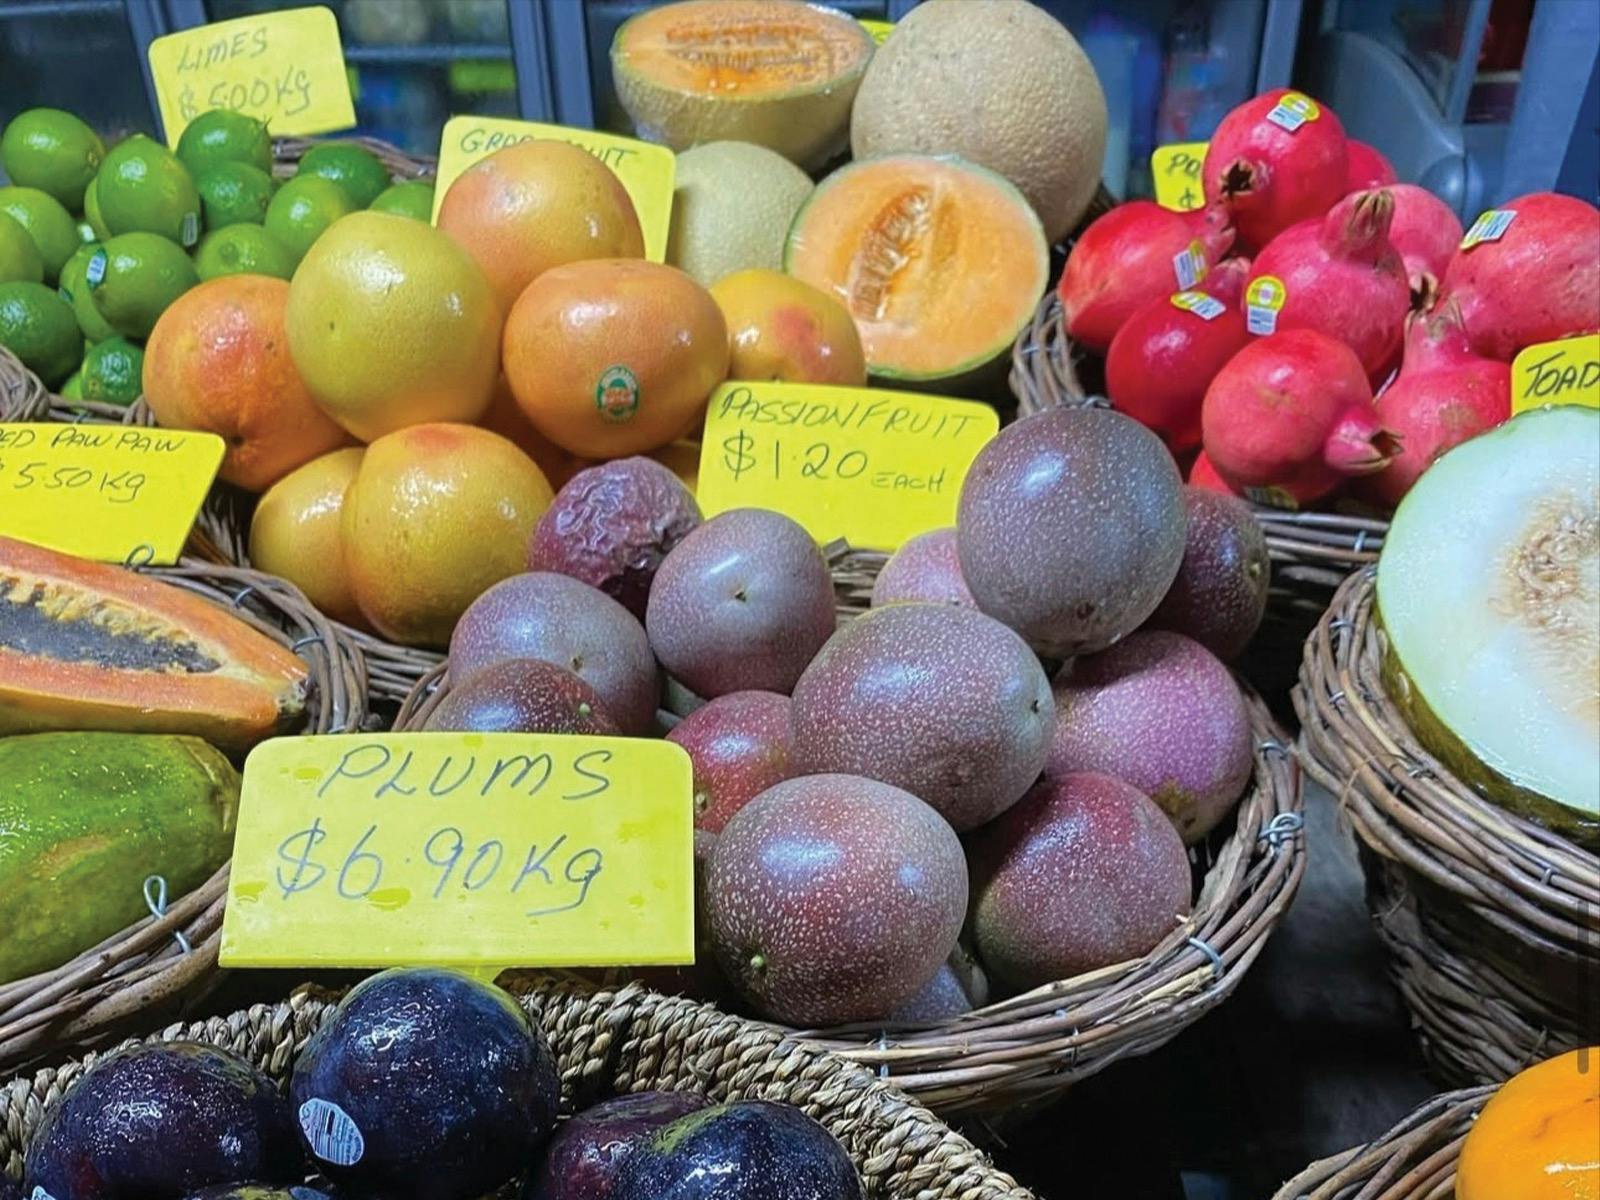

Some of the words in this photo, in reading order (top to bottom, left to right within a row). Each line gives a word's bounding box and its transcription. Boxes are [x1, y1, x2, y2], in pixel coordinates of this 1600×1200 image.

[177, 26, 268, 75] LIMES
[1523, 351, 1600, 399] TOAD
[51, 426, 114, 449] PAW
[114, 430, 187, 452] PAW
[871, 467, 946, 494] EACH
[316, 743, 613, 800] PLUMS
